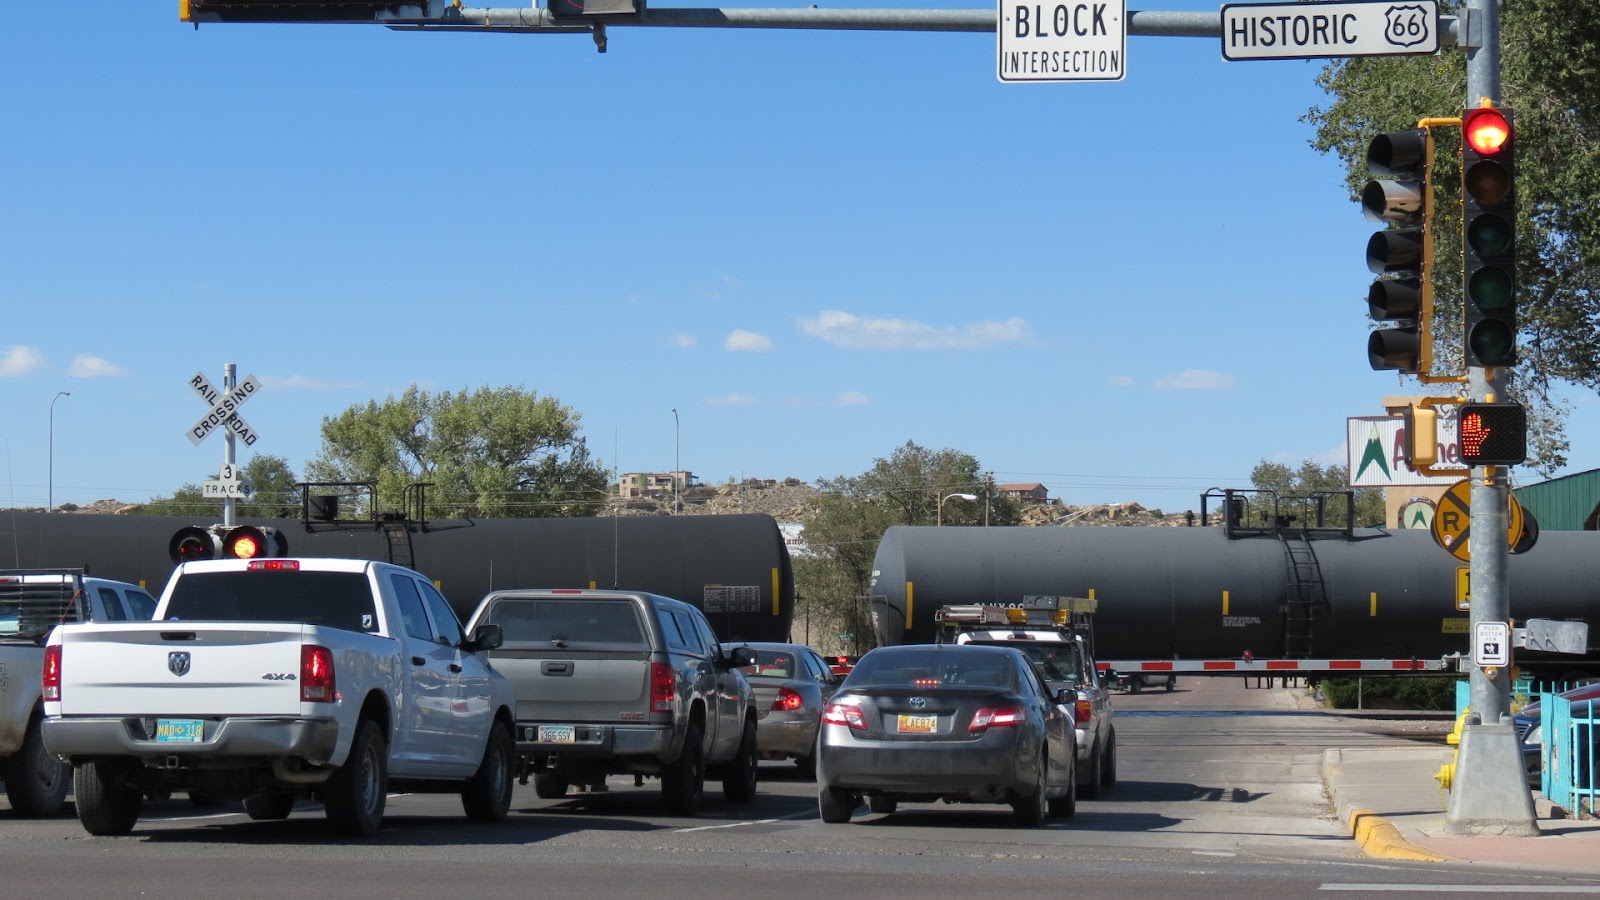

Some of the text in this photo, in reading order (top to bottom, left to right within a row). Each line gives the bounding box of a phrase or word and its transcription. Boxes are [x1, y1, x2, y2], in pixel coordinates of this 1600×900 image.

[1015, 3, 1108, 39] BLOCK
[1231, 14, 1421, 47] HISTORIC 66
[1003, 49, 1120, 75] INTERSECTION
[191, 376, 257, 446] RAIL ROAD
[193, 381, 255, 439] CROSSING
[224, 466, 232, 479] 3
[205, 484, 250, 494] TRACKS
[1442, 511, 1460, 532] R
